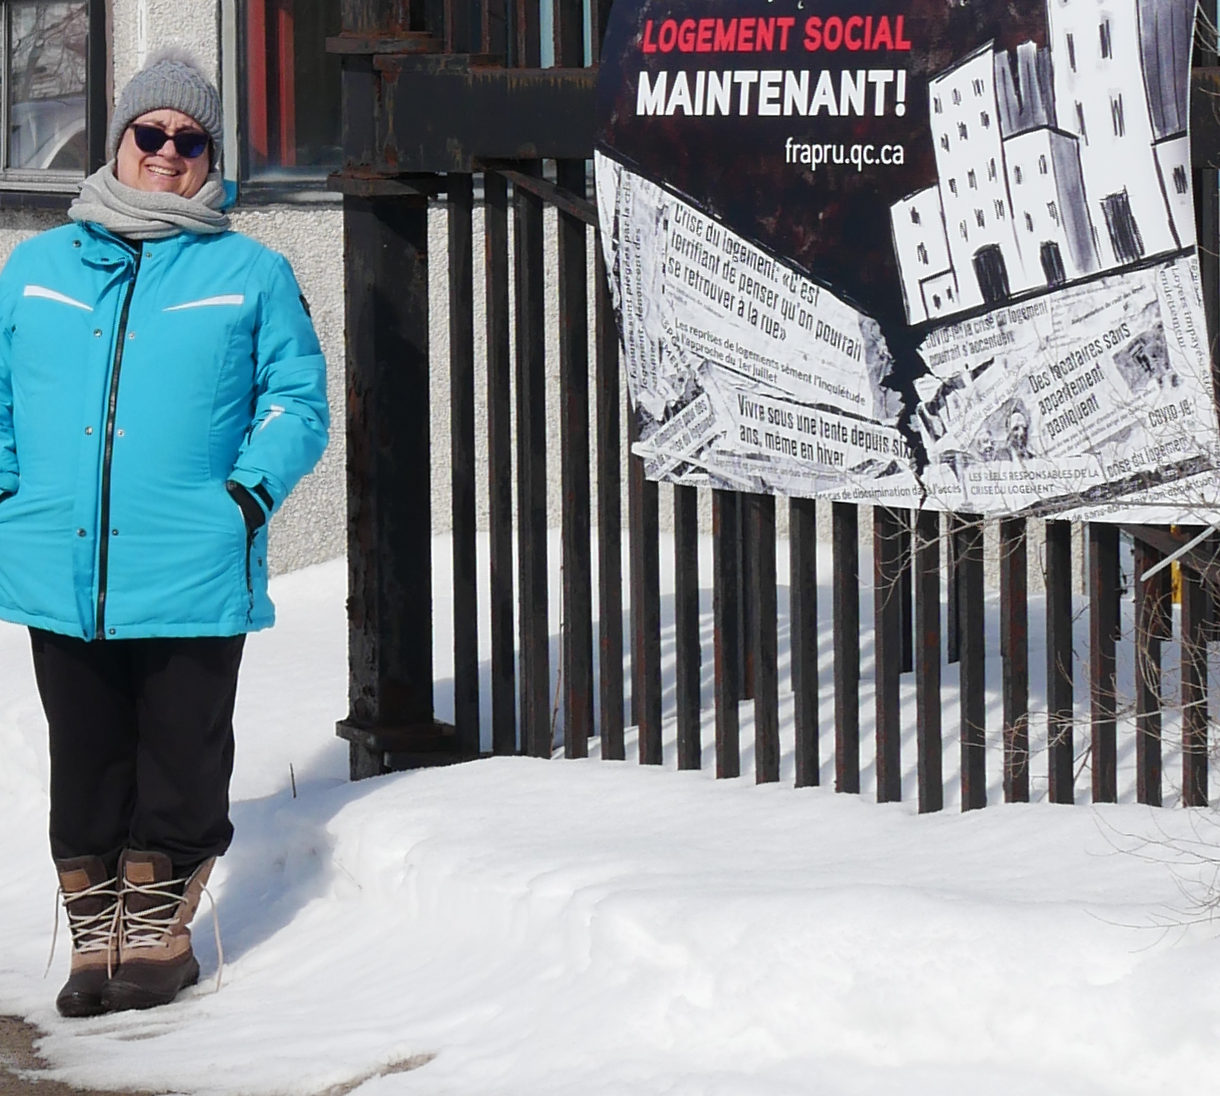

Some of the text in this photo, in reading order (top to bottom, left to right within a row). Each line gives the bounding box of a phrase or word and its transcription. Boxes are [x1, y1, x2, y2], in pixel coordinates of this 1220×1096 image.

[643, 16, 911, 52] LOGEMENT SOCIAL
[637, 70, 906, 116] MAINTENANT!
[786, 137, 903, 171] frapru.qc.ca
[620, 220, 633, 244] par
[633, 228, 642, 250] des
[706, 222, 720, 248] du
[671, 229, 720, 275] terrifiant
[723, 258, 736, 284] de
[738, 272, 778, 310] penser
[780, 296, 814, 331] qu'on
[667, 256, 682, 278] se
[684, 264, 736, 312] retrouver
[738, 296, 745, 318] à
[748, 300, 758, 326] la
[760, 314, 786, 341] rue»
[1008, 300, 1048, 324] logement
[674, 318, 688, 333] Les
[689, 327, 722, 348] reprises
[724, 338, 734, 351] de
[735, 342, 779, 371] logements
[814, 374, 866, 406] l'inquiétude
[725, 352, 736, 366] du
[738, 356, 751, 372] 1er
[752, 363, 778, 384] juillet
[1028, 322, 1131, 394] Des locataires sans
[1038, 362, 1105, 416] appartement
[738, 393, 764, 421] Vivre
[768, 406, 794, 429] sous
[796, 413, 816, 436] une
[820, 417, 848, 444] tente
[851, 424, 888, 454] depuis
[1046, 392, 1100, 439] paniquent
[765, 431, 797, 457] même
[800, 442, 814, 461] en
[816, 442, 845, 468] hiver
[968, 472, 982, 482] LES
[1075, 468, 1087, 479] DE
[1089, 468, 1100, 478] LA
[970, 485, 994, 496] CRISE
[994, 484, 1006, 495] DU
